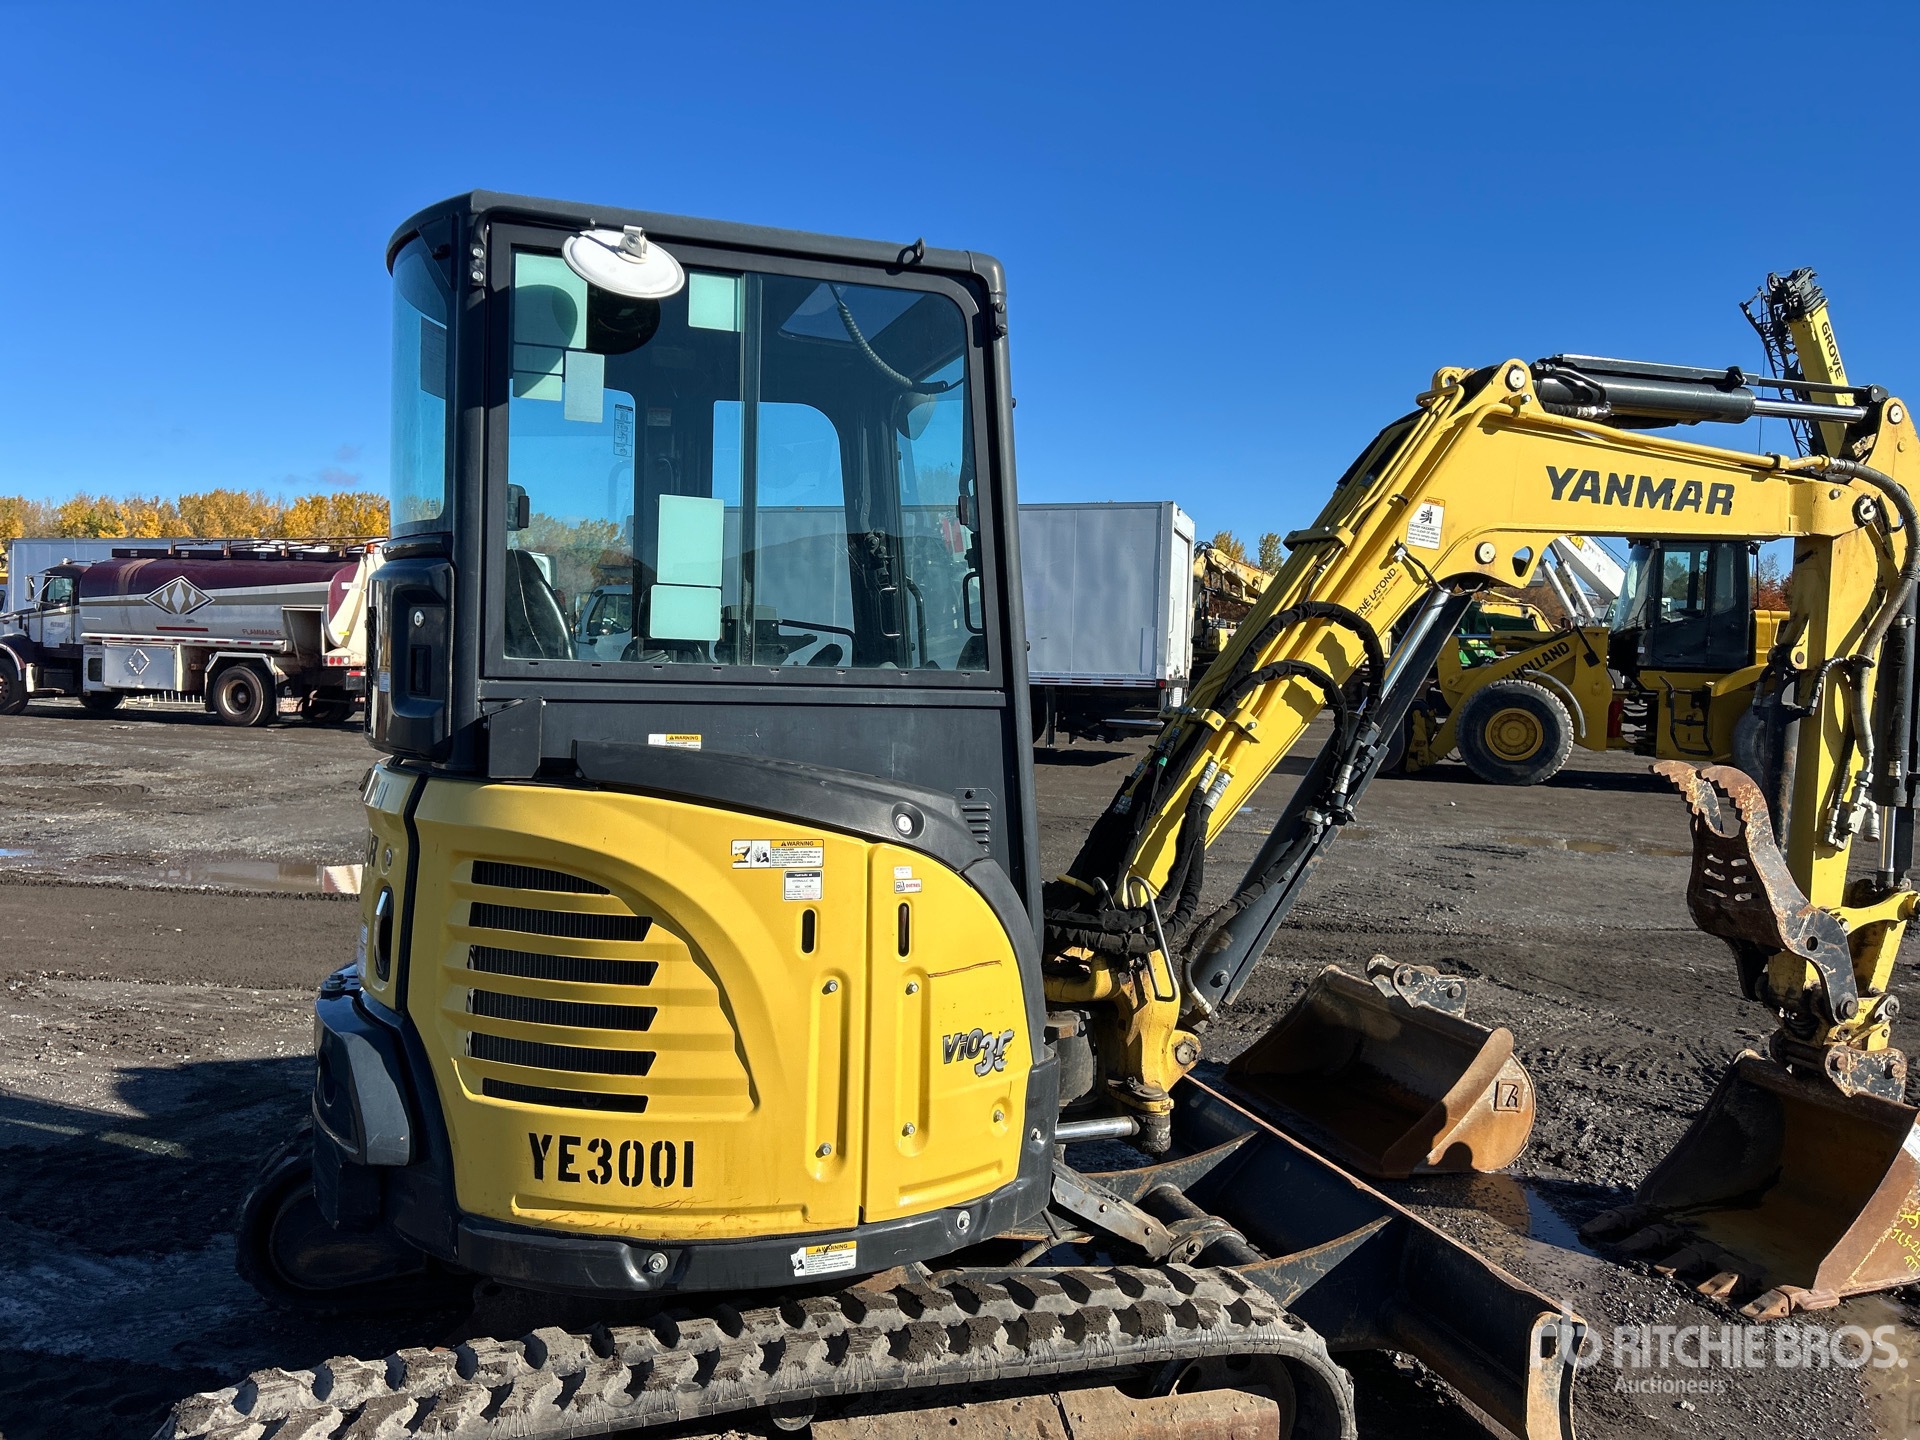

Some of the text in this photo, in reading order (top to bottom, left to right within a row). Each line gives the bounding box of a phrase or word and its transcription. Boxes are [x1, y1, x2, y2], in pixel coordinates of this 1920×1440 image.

[1821, 321, 1844, 380] GROVE
[1546, 465, 1735, 516] YANMAR
[1354, 597, 1371, 616] ENÉ
